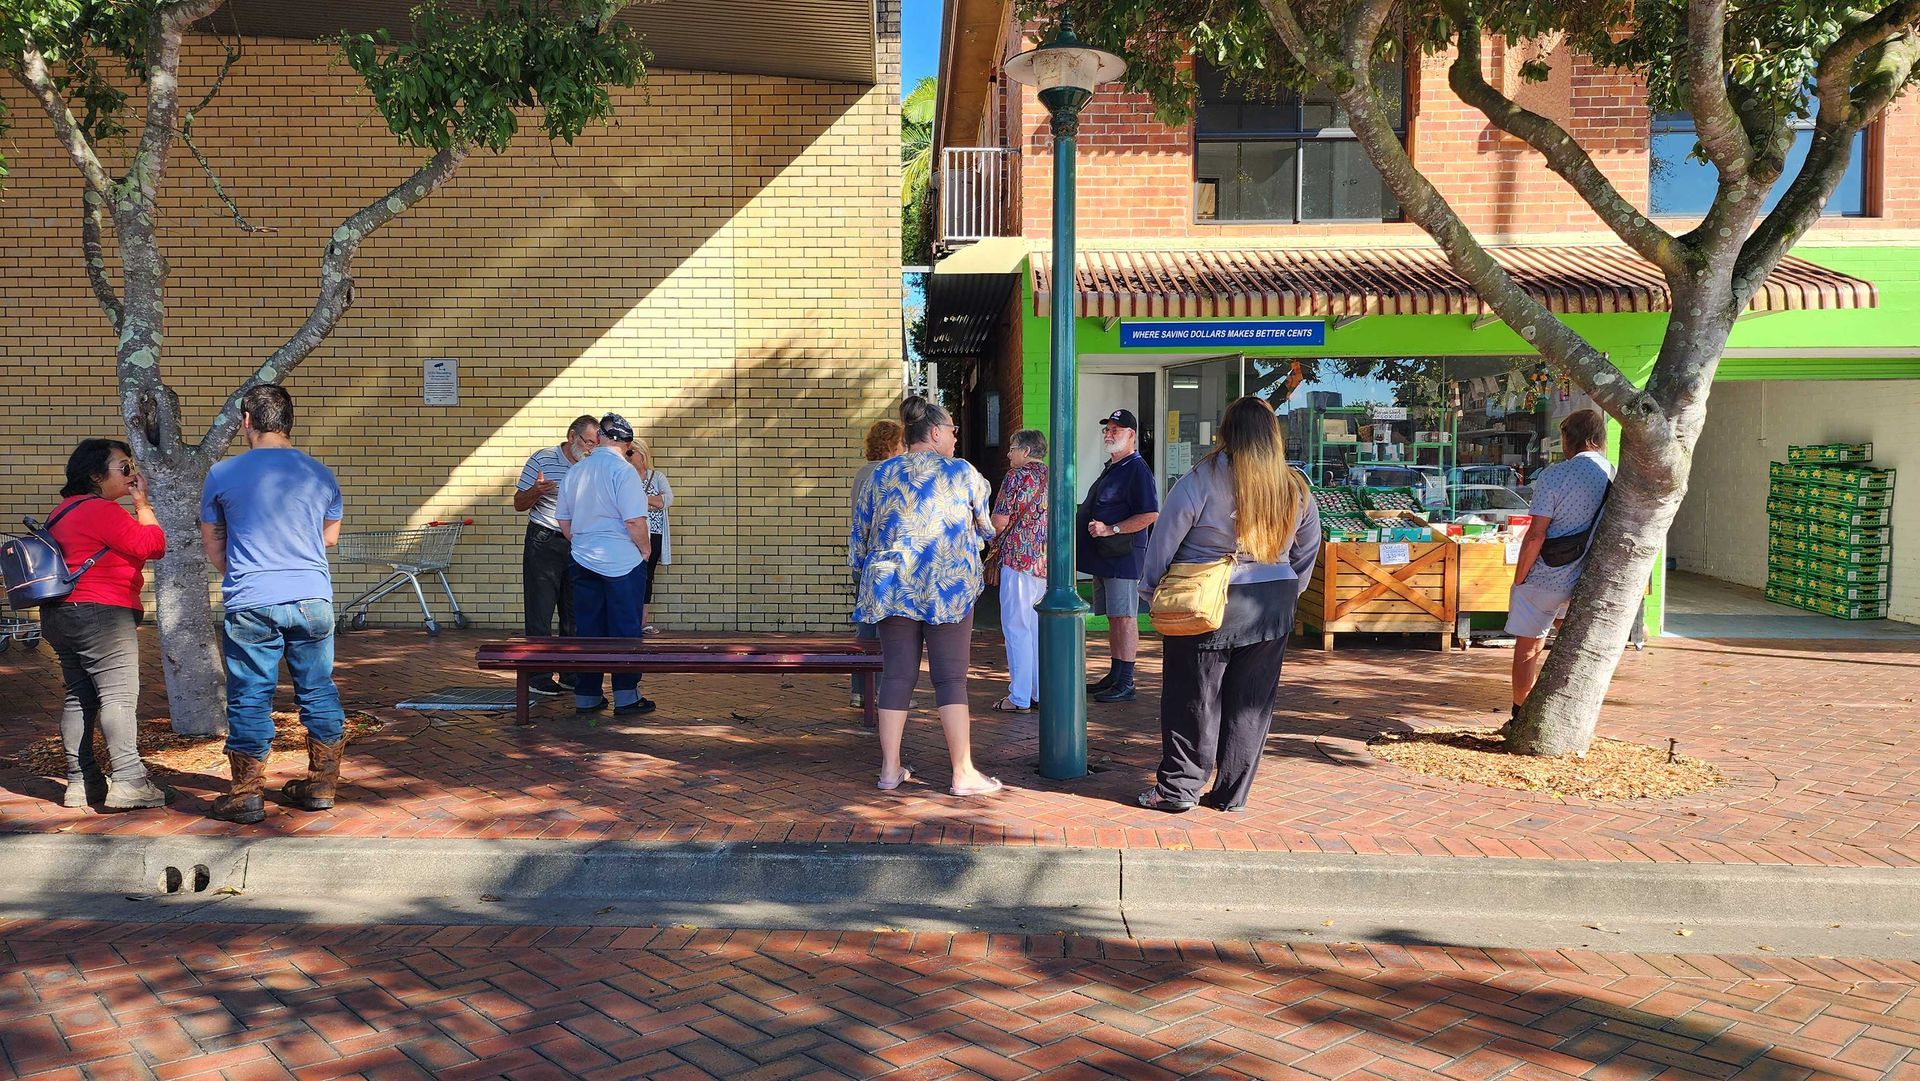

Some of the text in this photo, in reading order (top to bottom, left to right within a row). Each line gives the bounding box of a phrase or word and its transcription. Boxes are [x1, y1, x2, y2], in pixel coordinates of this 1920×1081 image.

[1132, 328, 1312, 339] WHERE SAVING DOLLARS MAKES BETTER CENTS
